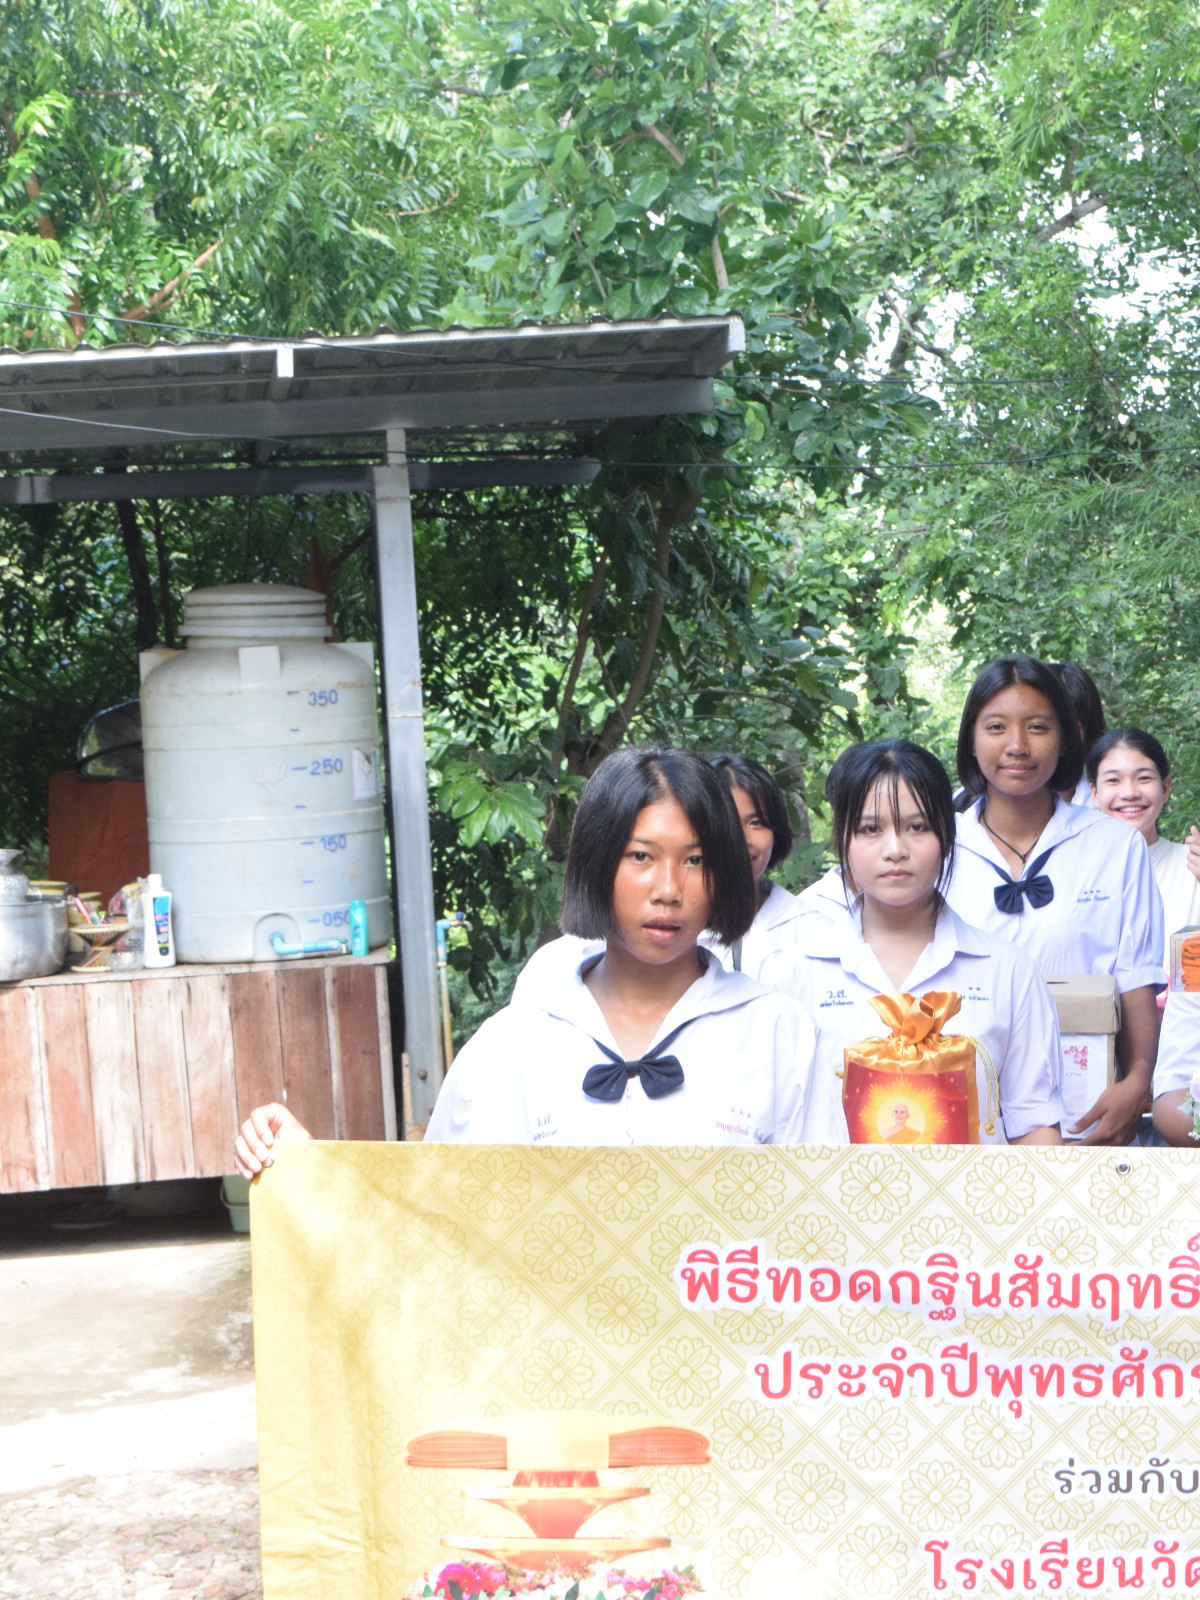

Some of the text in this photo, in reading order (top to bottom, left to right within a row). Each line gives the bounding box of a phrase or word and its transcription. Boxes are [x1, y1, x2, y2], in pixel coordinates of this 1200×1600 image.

[308, 689, 339, 707] 350
[310, 758, 344, 776] 250
[319, 834, 347, 852] 150
[1053, 1457, 1200, 1495] ร่วมกับ
